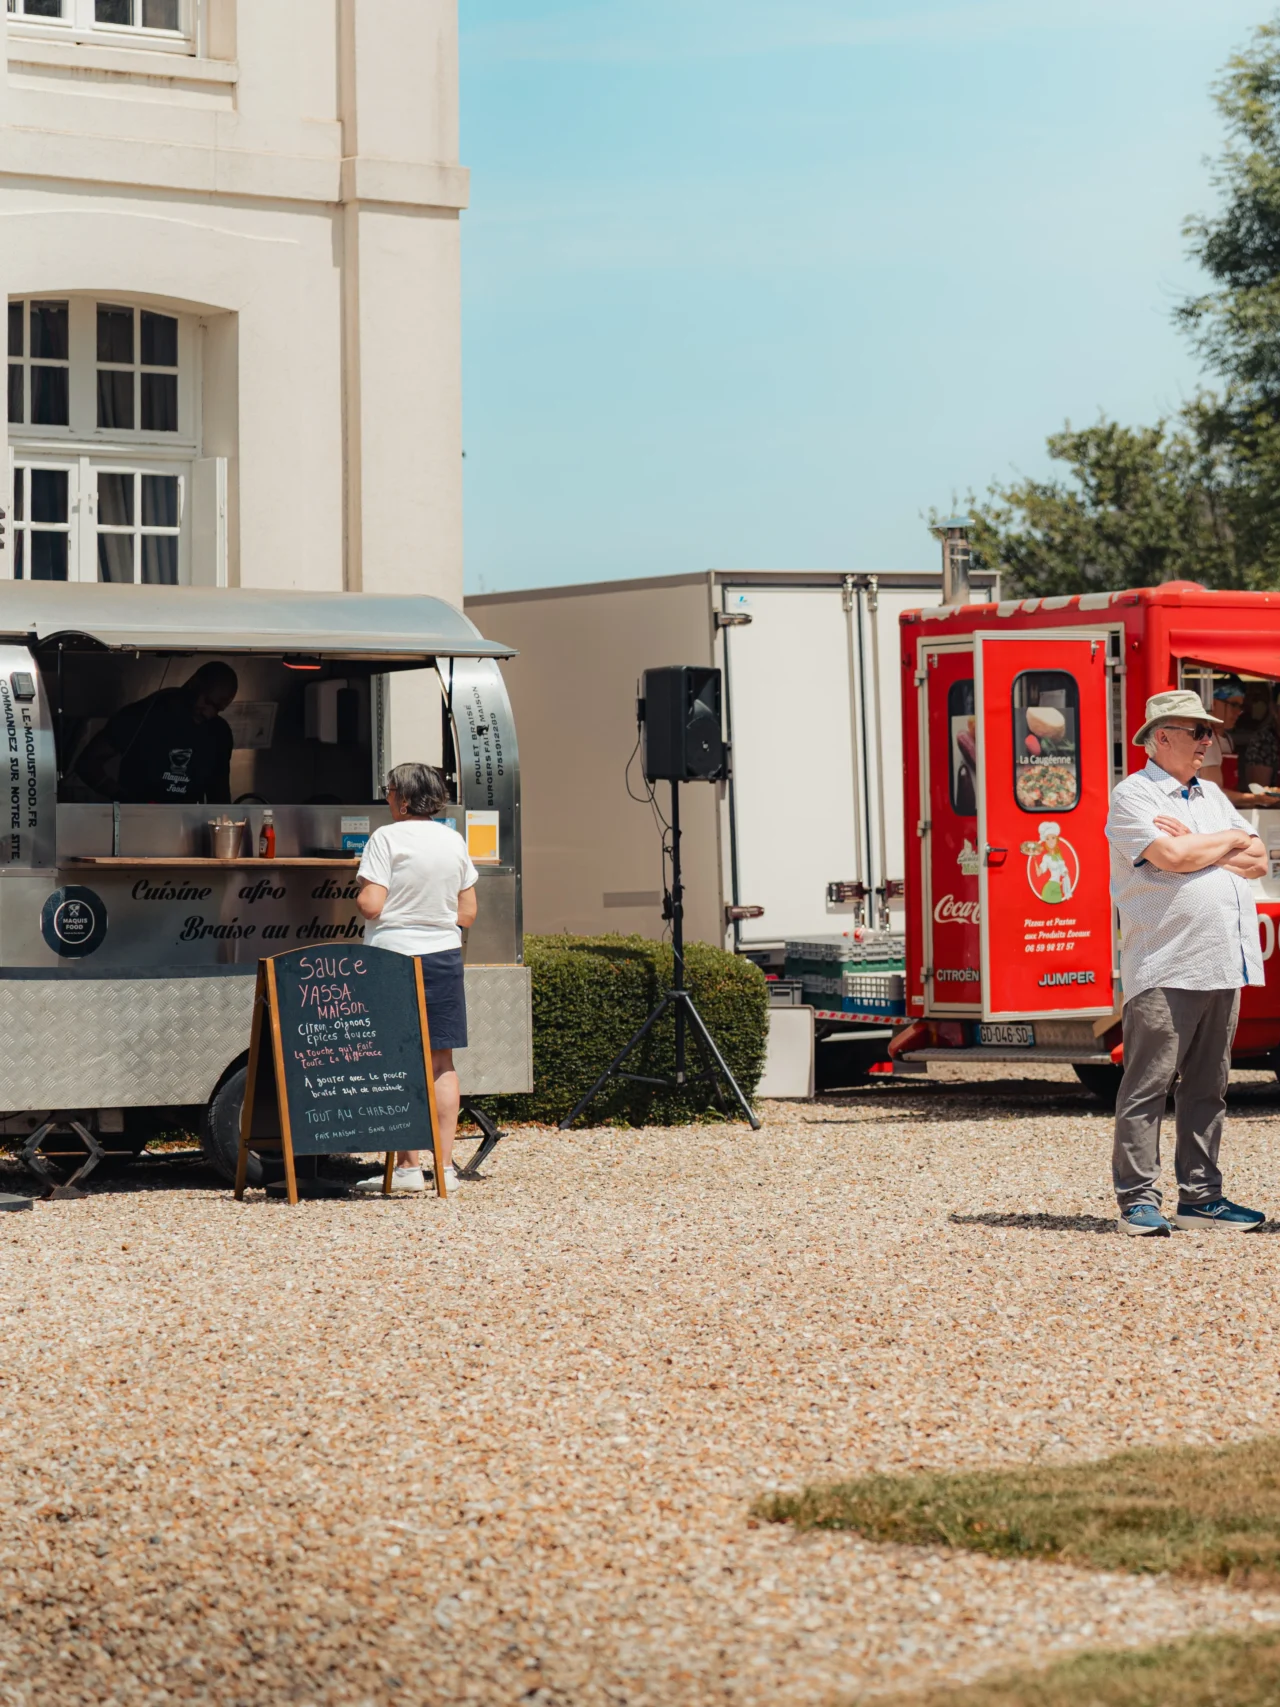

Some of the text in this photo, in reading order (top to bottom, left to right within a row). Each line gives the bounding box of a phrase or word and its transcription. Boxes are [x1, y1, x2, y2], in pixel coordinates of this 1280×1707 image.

[472, 686, 486, 723] MAISON
[0, 679, 20, 860] COMMANDEZ SUR NOTRE SITE
[21, 707, 37, 828] LE-MAQUISFOOD.FR
[473, 744, 482, 785] POULET
[1020, 756, 1029, 764] La
[162, 771, 190, 784] Maquis
[485, 755, 494, 807] BURGERS
[166, 784, 186, 794] Food
[132, 879, 212, 900] Cuisine
[238, 879, 286, 904] afro
[179, 915, 256, 941] Braise
[261, 924, 290, 939] au
[1025, 944, 1034, 952] 06
[1066, 942, 1074, 950] 57
[300, 957, 367, 980] Sauce
[936, 968, 979, 981] CITROËN
[1038, 970, 1095, 986] JUMPER
[299, 983, 352, 1008] YASSA
[344, 1031, 376, 1040] douces
[981, 1026, 1028, 1042] GD-046-SD
[338, 1044, 352, 1056] qui
[342, 1087, 358, 1096] 24h
[305, 1102, 410, 1124] TOUT AU CHARBON
